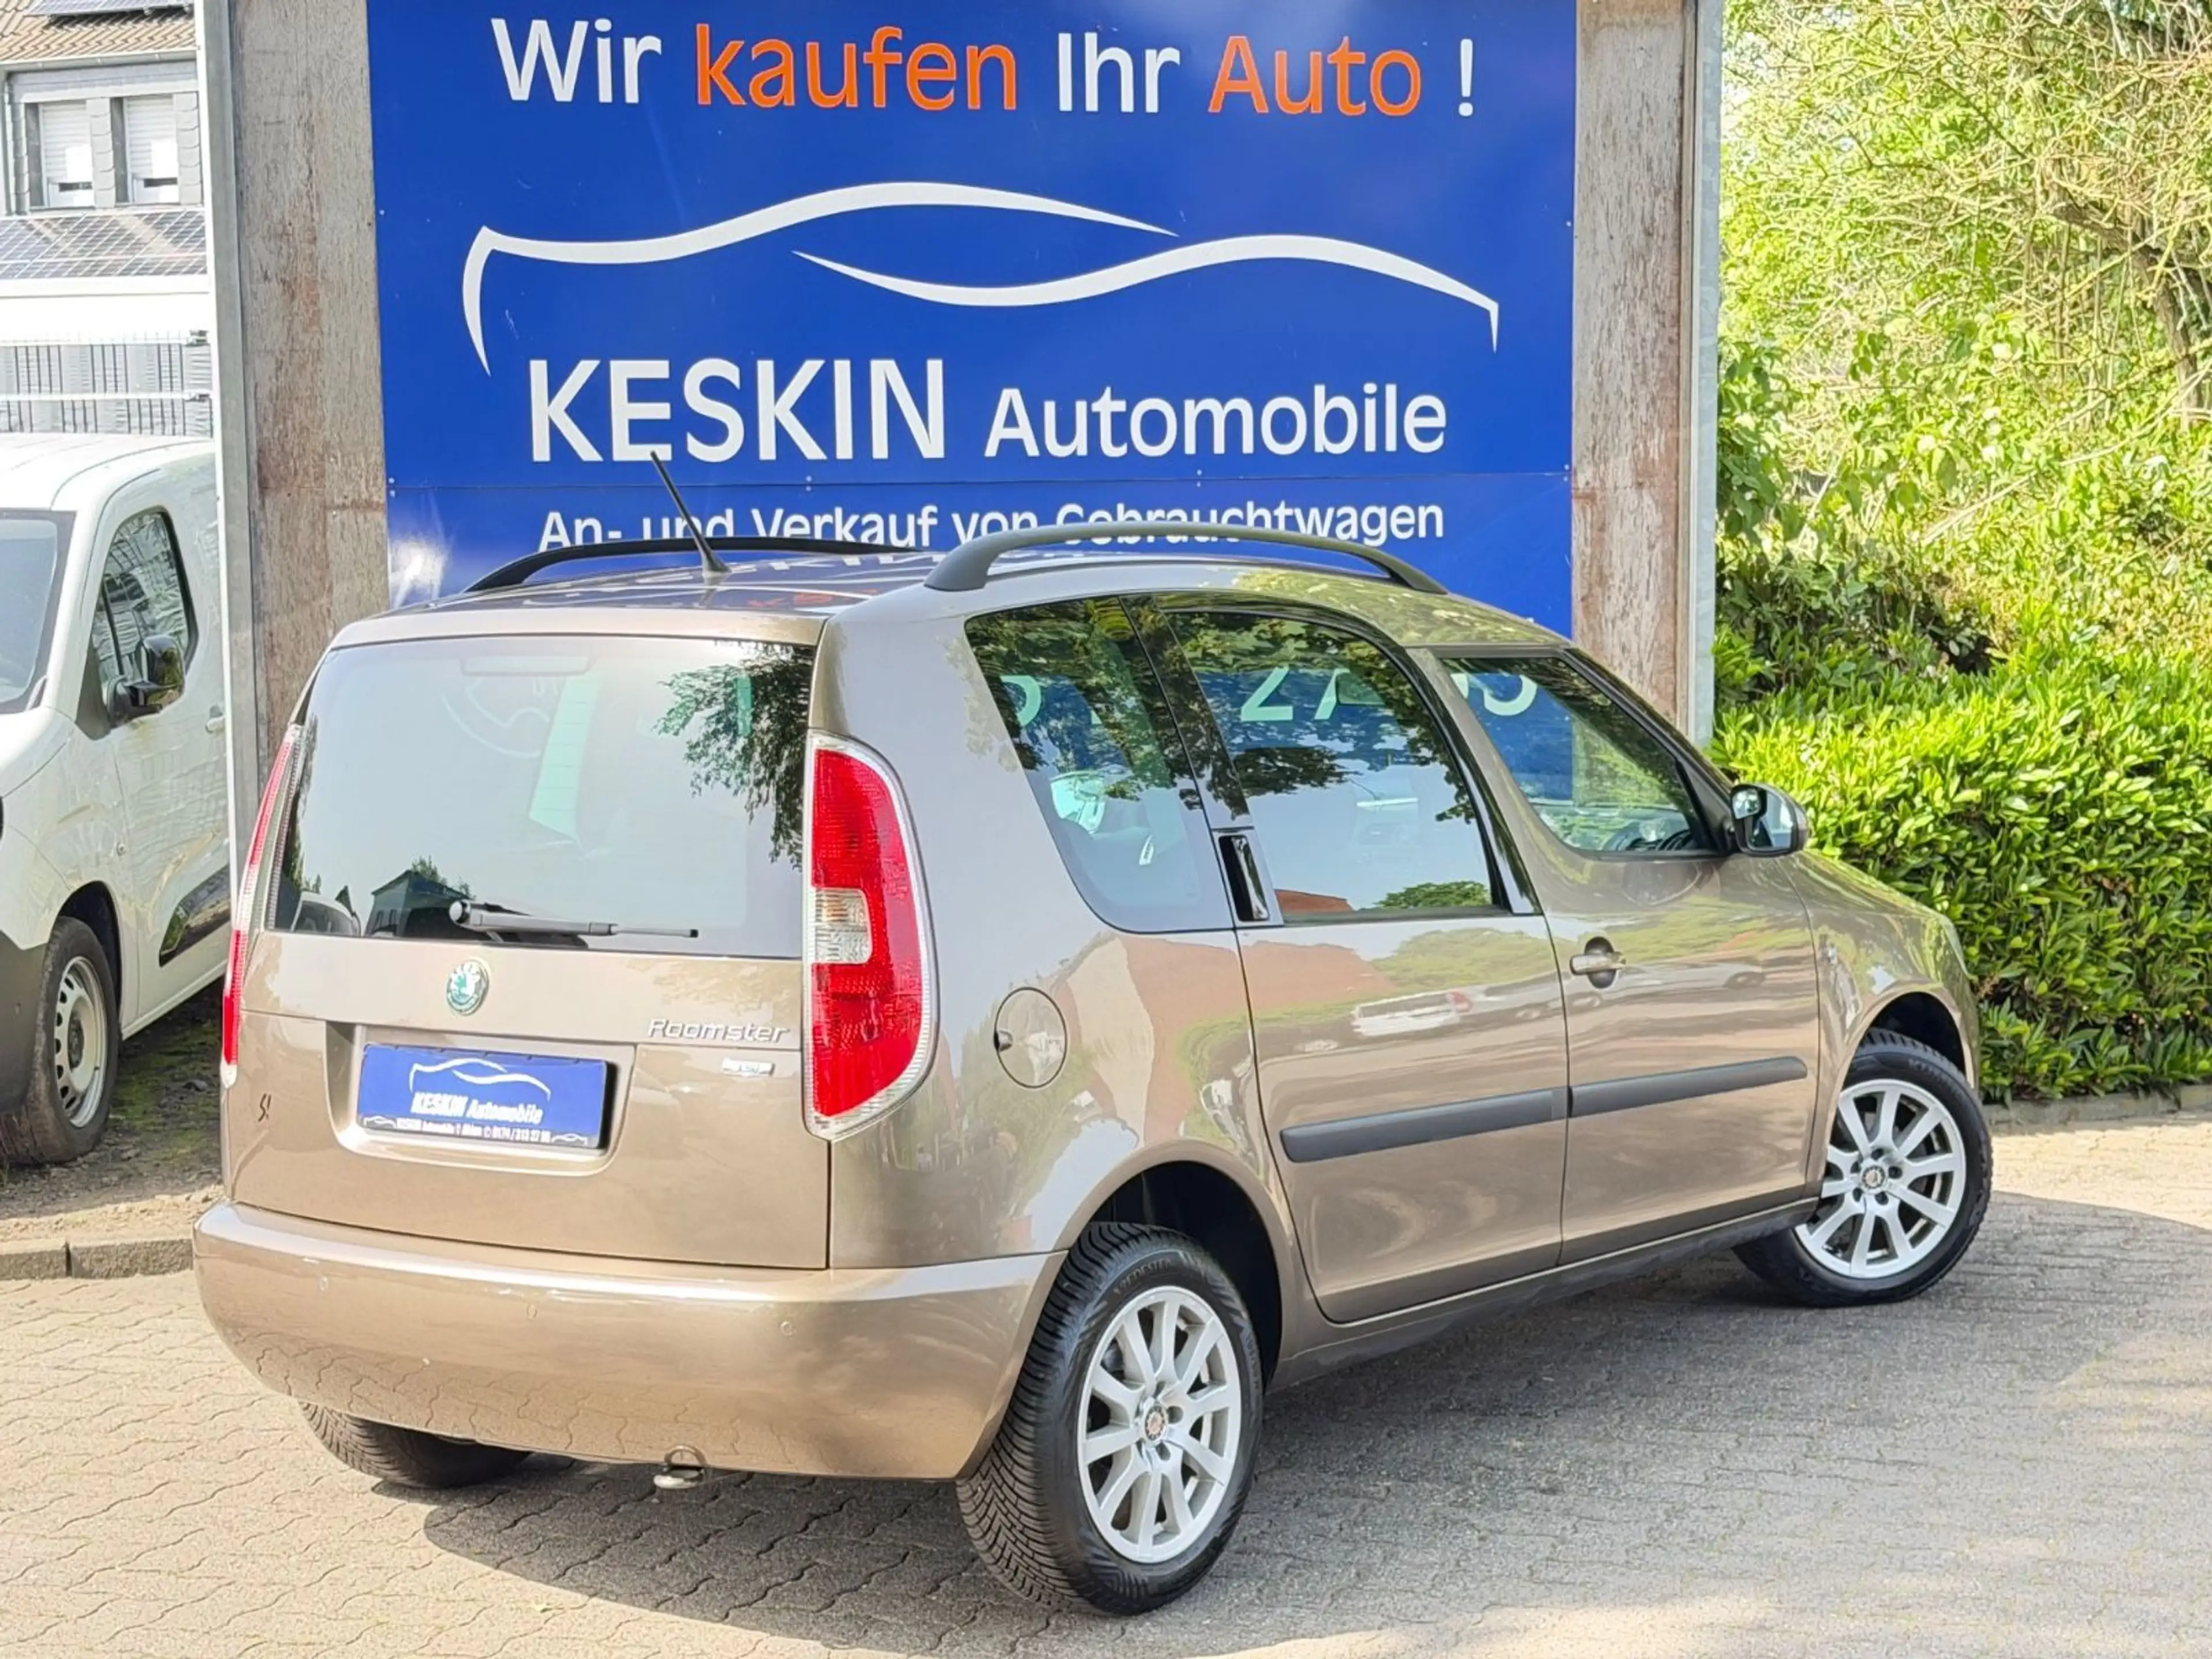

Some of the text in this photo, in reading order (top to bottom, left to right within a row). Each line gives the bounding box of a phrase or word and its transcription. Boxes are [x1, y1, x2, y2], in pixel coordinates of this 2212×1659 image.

[490, 17, 1474, 116] Wir kaufen Ihr Auto !
[529, 357, 1447, 463] KESKIN Automobile
[538, 510, 622, 552] An-
[751, 504, 938, 548] Verkauf
[647, 1018, 791, 1043] Roomster
[411, 1091, 544, 1125] KESKIN Automobile
